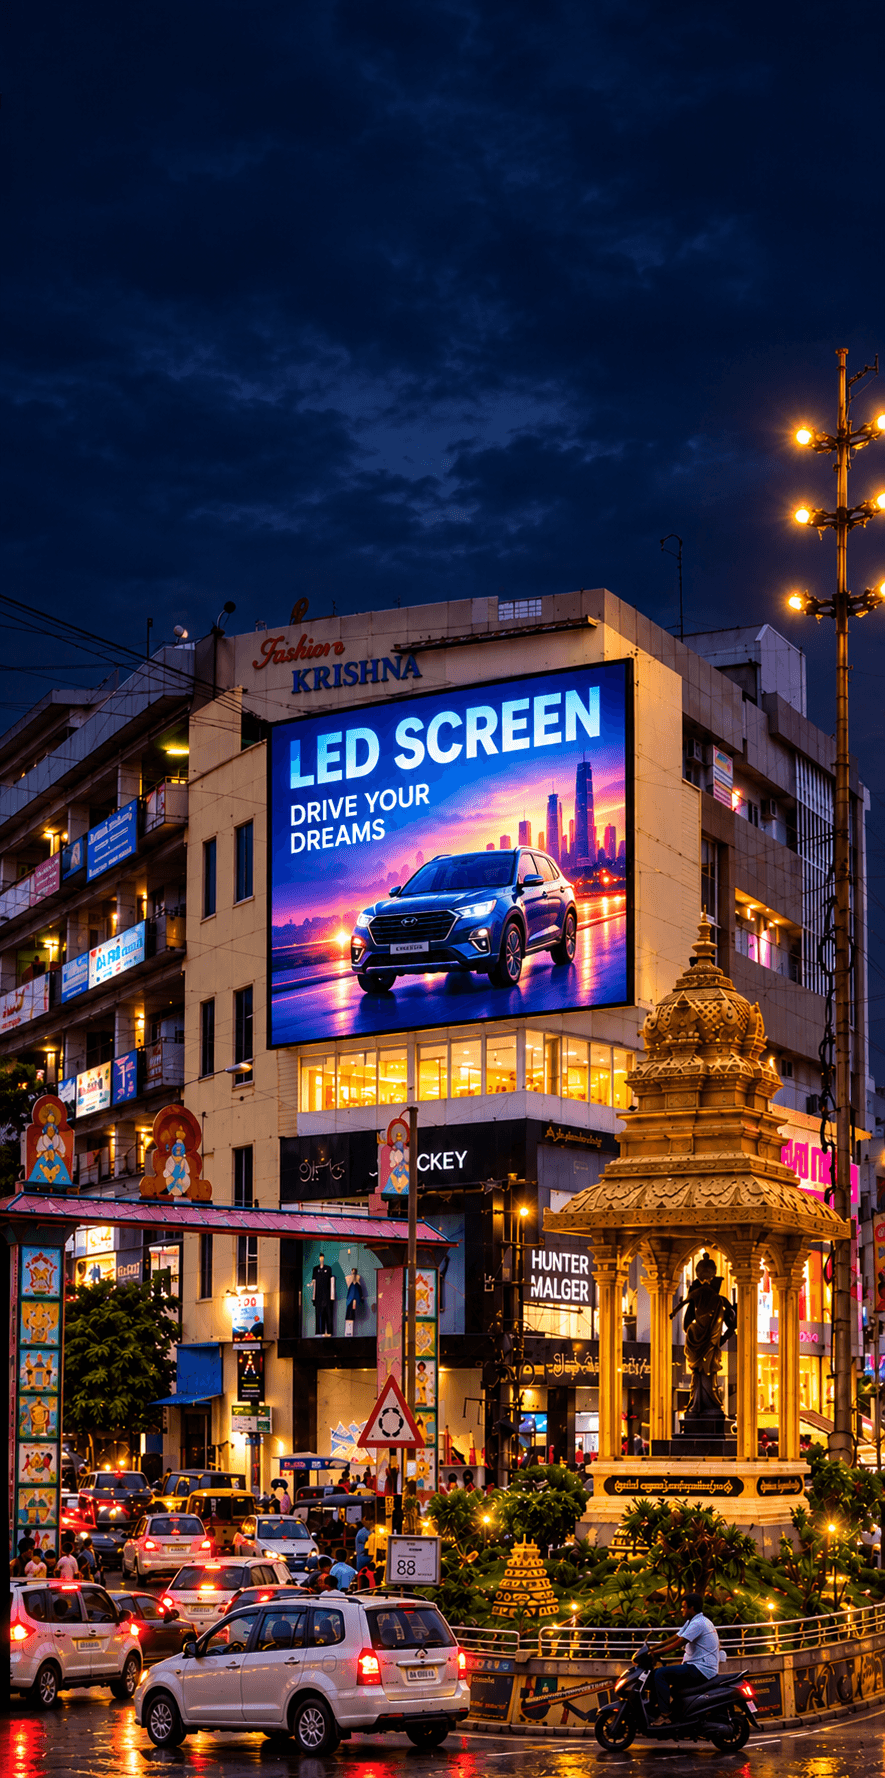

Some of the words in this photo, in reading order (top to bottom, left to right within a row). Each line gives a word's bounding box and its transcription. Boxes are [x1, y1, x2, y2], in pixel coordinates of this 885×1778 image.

[291, 655, 423, 693] KRISHNA
[290, 727, 380, 789] LED
[394, 686, 600, 769] SCREEN
[290, 794, 358, 826] DRIVE
[364, 784, 430, 813] YOUR
[290, 818, 386, 854] DREAMS
[532, 1249, 589, 1275] HUNTER
[530, 1275, 589, 1302] MALGER
[397, 1559, 416, 1576] 88
